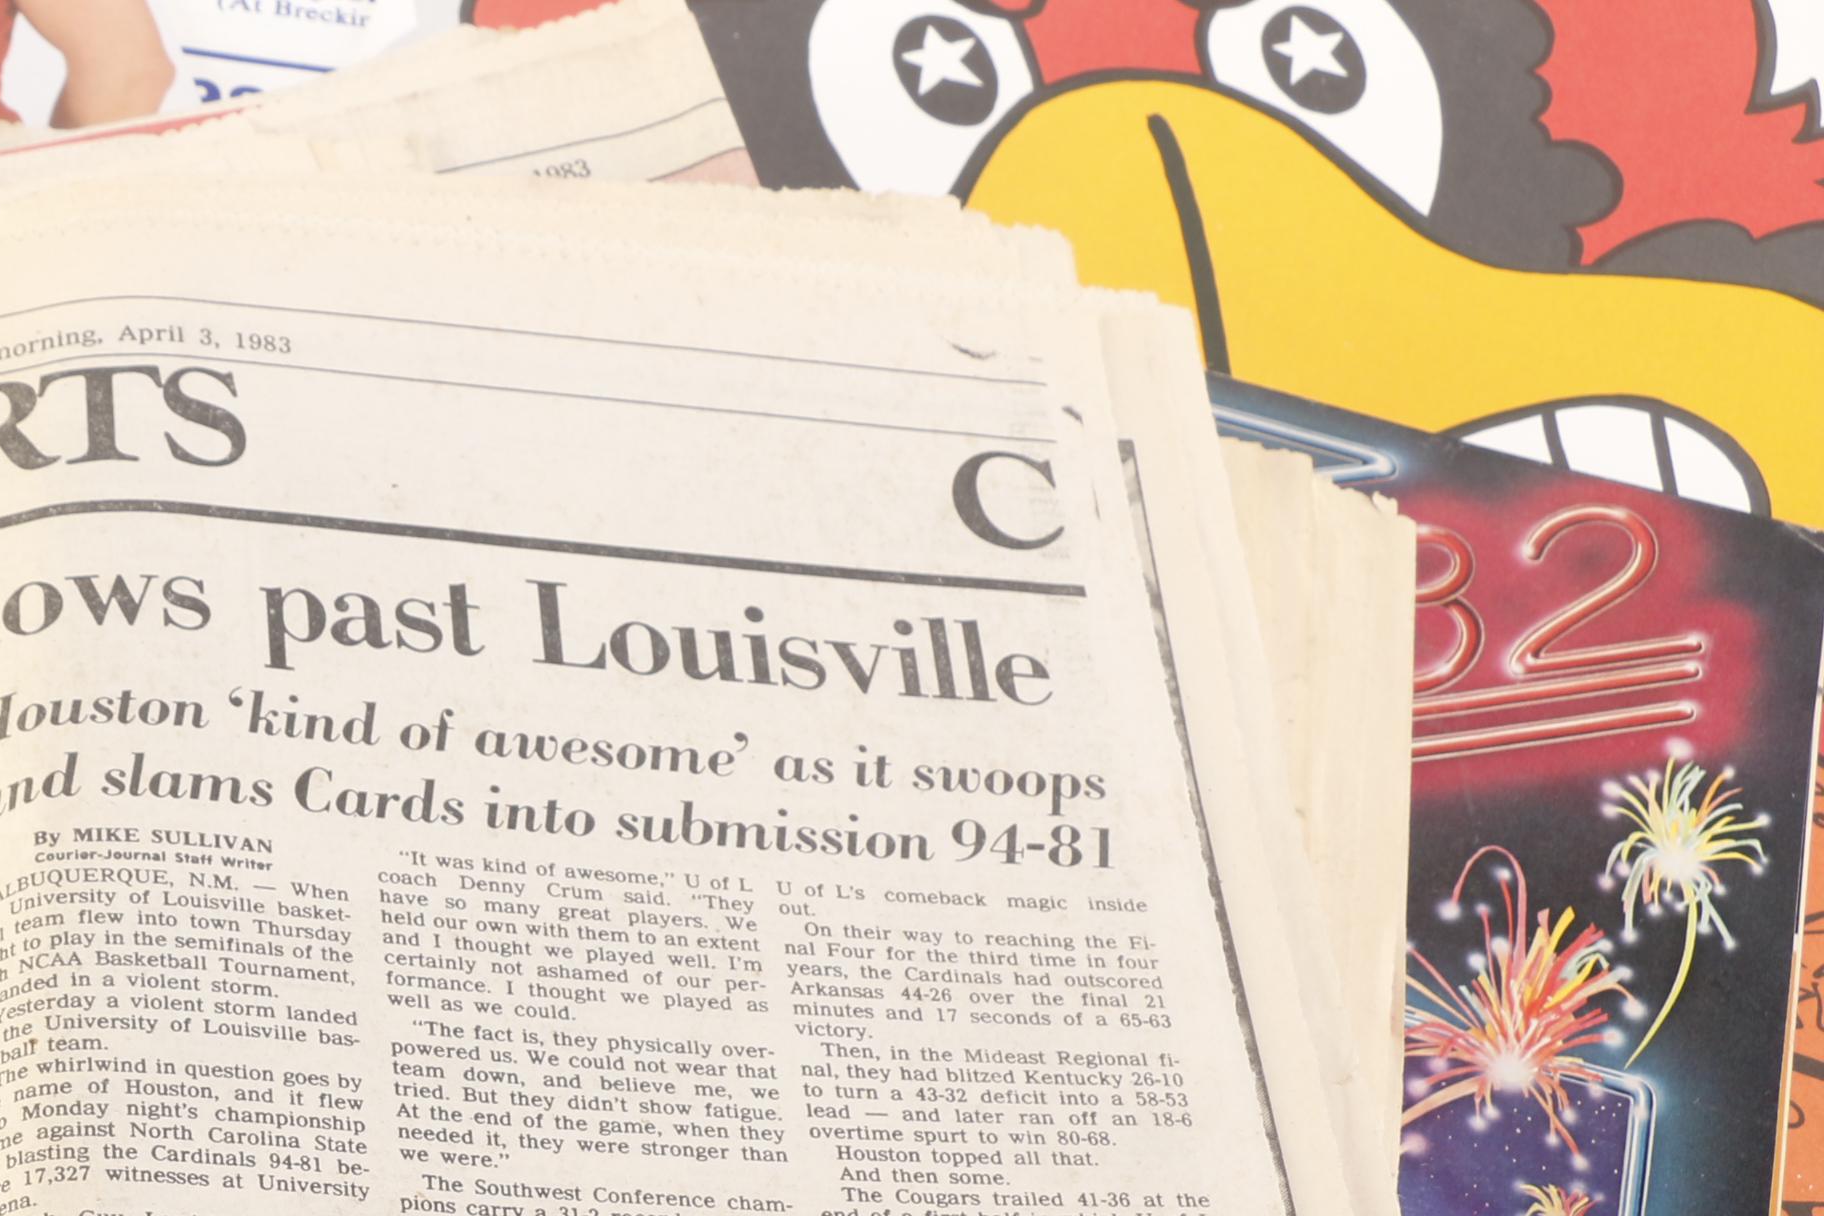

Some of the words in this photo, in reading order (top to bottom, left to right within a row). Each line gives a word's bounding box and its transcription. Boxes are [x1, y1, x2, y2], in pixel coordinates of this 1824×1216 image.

[117, 324, 185, 346] April
[199, 327, 221, 350] 3,
[235, 331, 292, 355] 1983
[952, 450, 1065, 550] C
[259, 582, 486, 671] past
[525, 574, 1058, 706] Louisville
[399, 708, 455, 752] of
[773, 755, 835, 784] as
[855, 744, 892, 789] it
[912, 764, 1106, 817] swoops
[100, 751, 273, 807] slams
[294, 766, 465, 825] Cards
[485, 784, 596, 837] into
[615, 800, 934, 862] submission
[951, 819, 1110, 869] 94-81
[33, 830, 61, 848] By
[73, 827, 140, 843] MIKE
[151, 829, 273, 857] SULLIVAN
[34, 848, 167, 864] Courier-Journal
[174, 852, 213, 866] Staff
[220, 855, 273, 872] Writer
[435, 855, 475, 871] was
[482, 857, 527, 875] kind
[535, 862, 556, 878] of
[683, 872, 700, 889] U
[709, 876, 730, 891] of
[738, 877, 754, 893] L
[188, 871, 239, 891] N.M.
[290, 881, 350, 902] When
[377, 871, 437, 888] coach
[458, 874, 526, 898] Denny
[546, 882, 603, 901] Crum
[623, 889, 671, 907] said.
[6, 887, 117, 919] University
[128, 889, 151, 905] of
[162, 886, 265, 914] Louisville
[277, 900, 351, 922] basket-
[789, 980, 885, 1000] Arkansas
[900, 986, 953, 1003] 44-26
[968, 991, 1015, 1005] over
[1031, 991, 1065, 1007] the
[1080, 992, 1129, 1008] final
[1144, 994, 1166, 1009] 21
[800, 1062, 840, 1081] nal,
[846, 1063, 891, 1084] they
[899, 1065, 939, 1082] had
[945, 1067, 1016, 1084] blitzed
[1023, 1069, 1123, 1089] Kentucky
[1131, 1071, 1184, 1088] 26-10
[835, 1144, 922, 1163] Houston
[930, 1148, 1003, 1168] topped
[1013, 1150, 1041, 1166] all
[1051, 1151, 1099, 1167] that.
